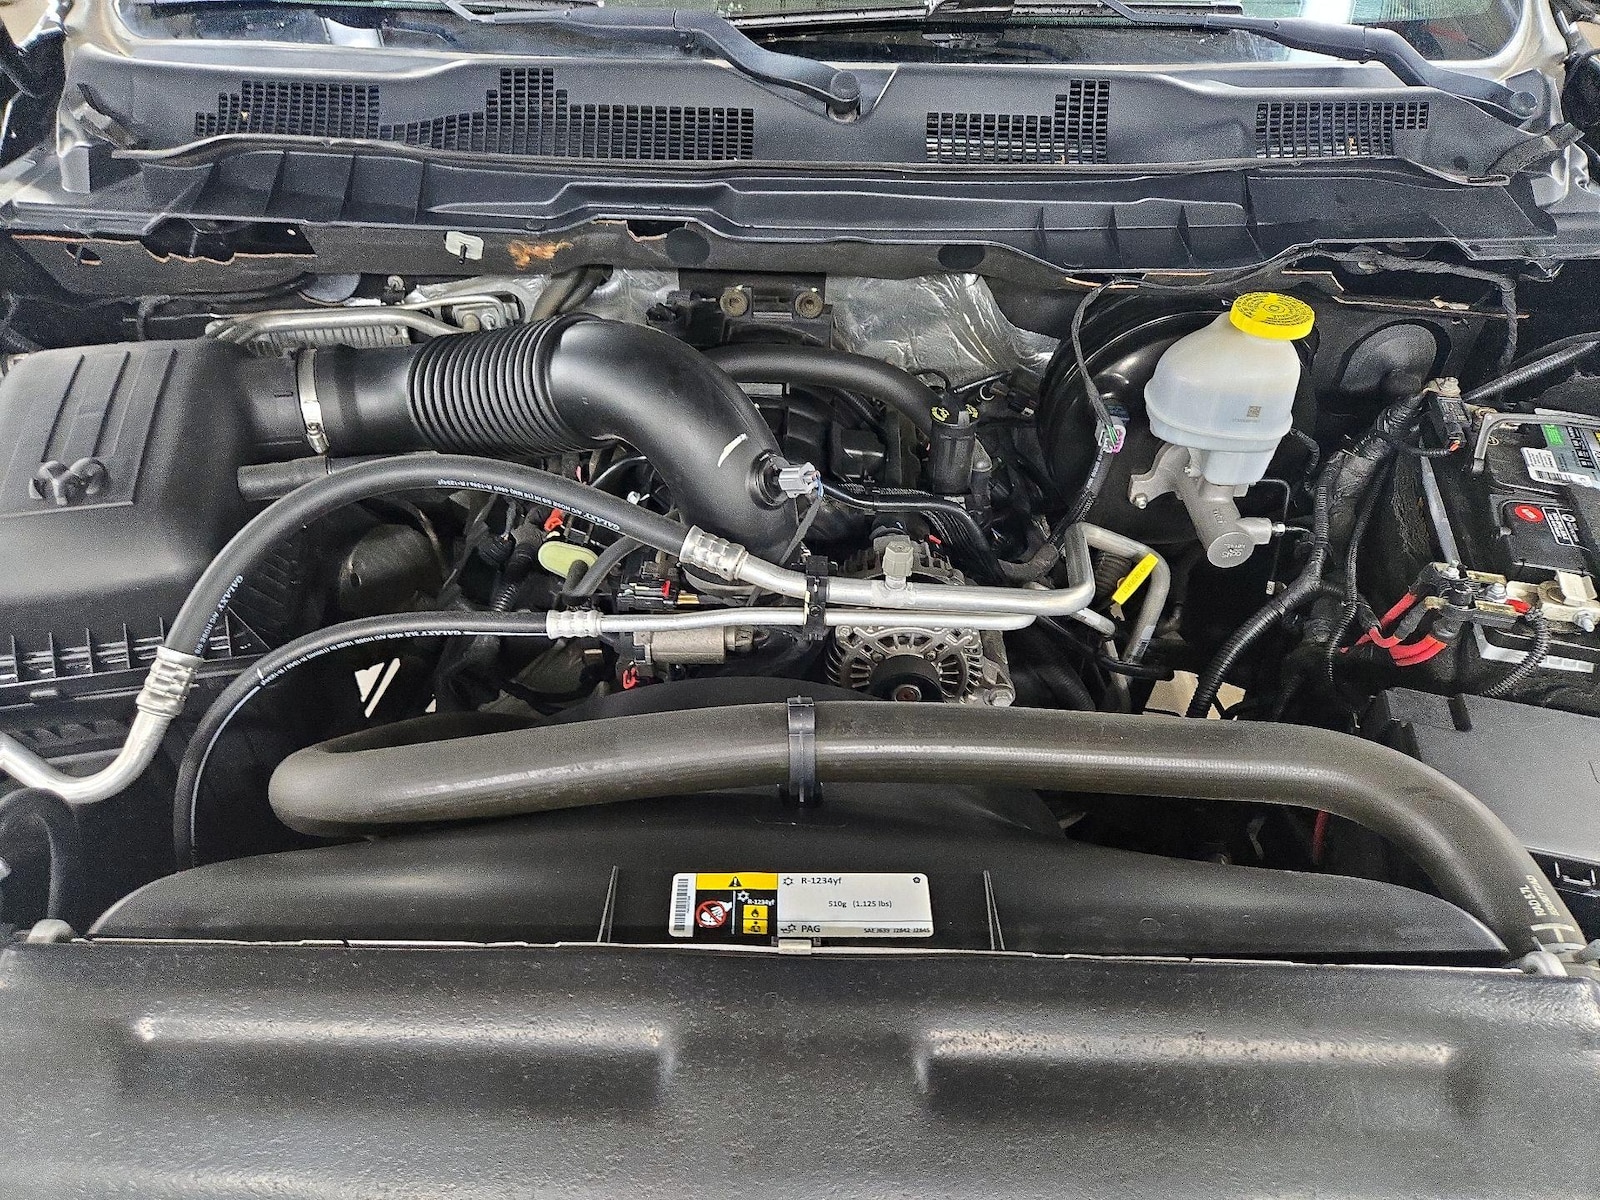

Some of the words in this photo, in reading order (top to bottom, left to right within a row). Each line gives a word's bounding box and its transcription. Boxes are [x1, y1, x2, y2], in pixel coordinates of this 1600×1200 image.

[552, 501, 571, 512] HOSE
[584, 511, 621, 531] GALAXY
[217, 574, 244, 612] GALAXY
[800, 876, 843, 886] R-1234yf
[828, 900, 847, 909] 510g
[852, 900, 876, 908] (1.125
[878, 900, 893, 908] lbs)
[801, 924, 821, 933] PAG
